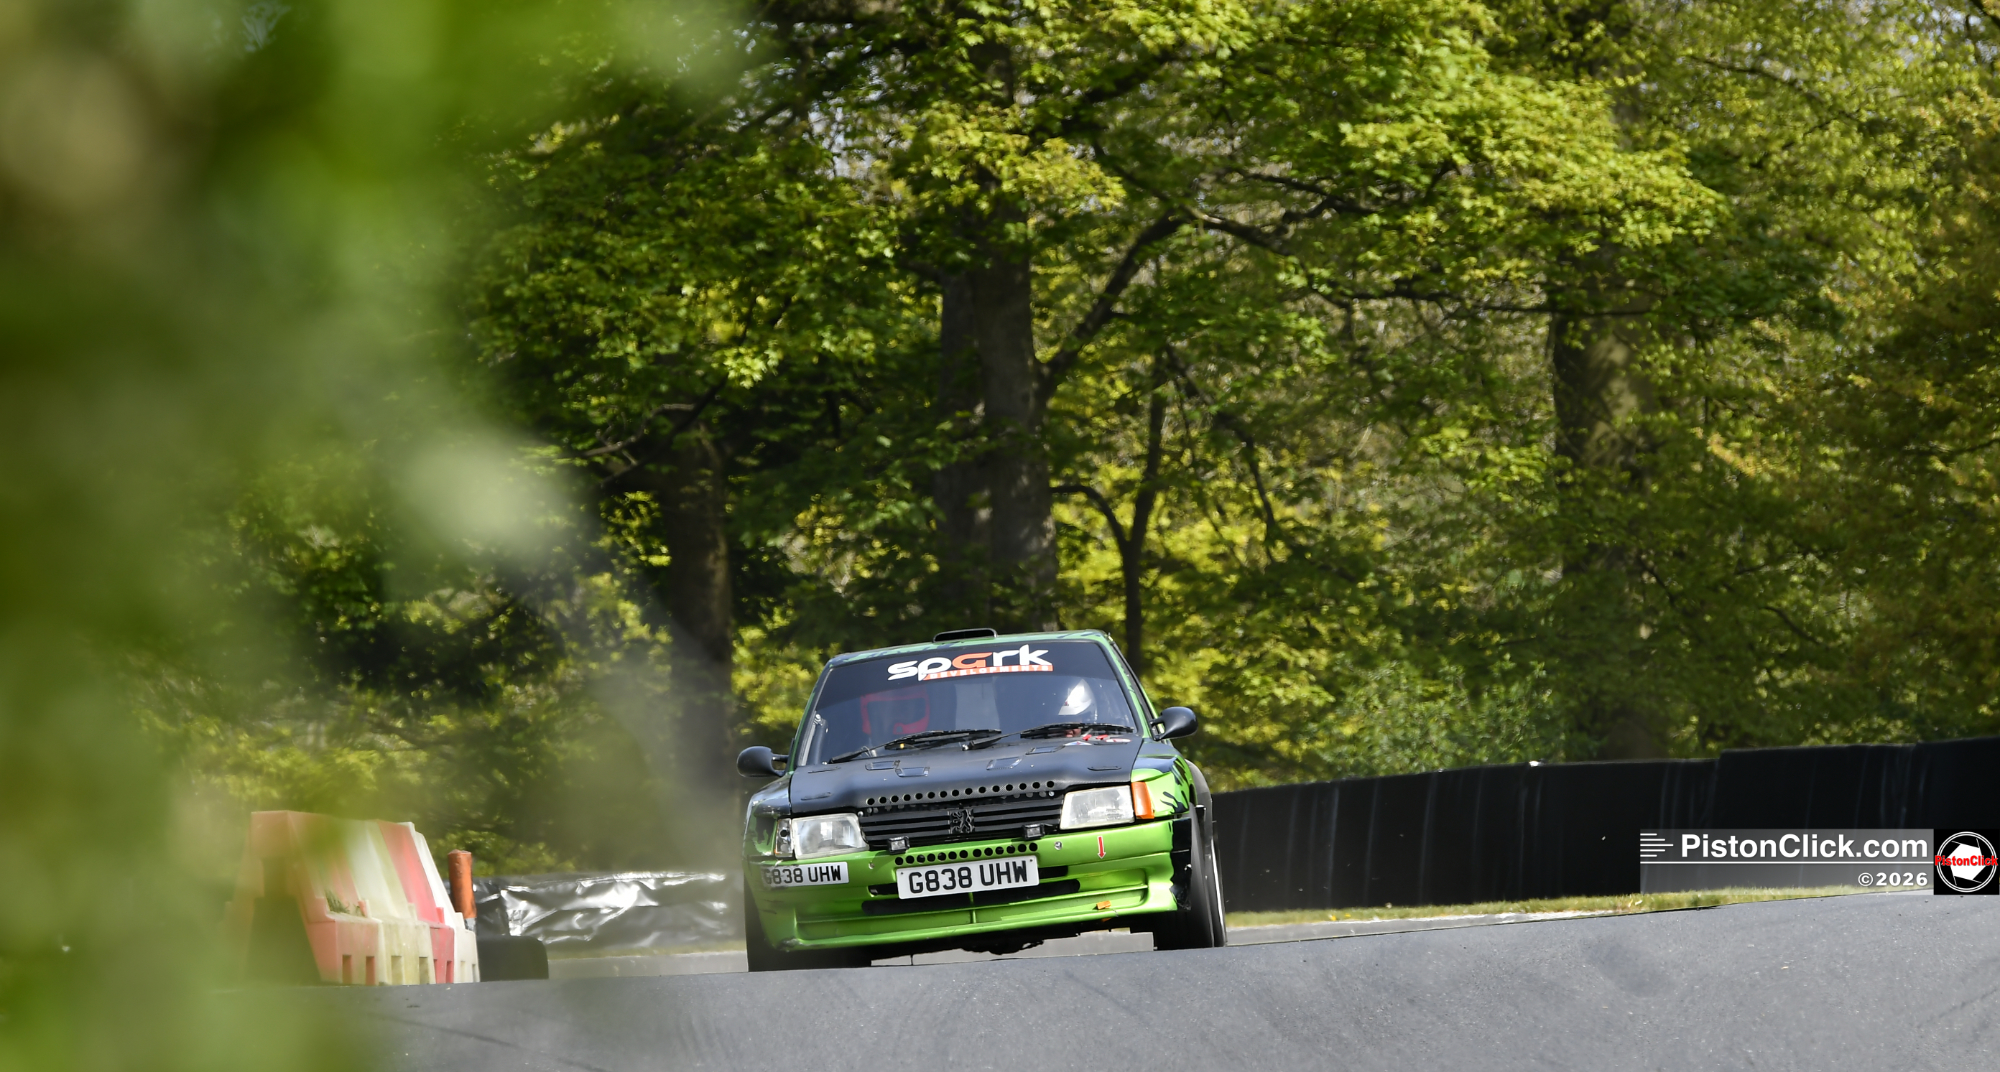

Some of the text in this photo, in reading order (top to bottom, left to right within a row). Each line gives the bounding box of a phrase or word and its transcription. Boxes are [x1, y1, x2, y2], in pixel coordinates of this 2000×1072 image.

[887, 644, 1053, 681] spark
[929, 664, 1049, 679] DEVELOPMENTS
[763, 863, 842, 885] G838 UHW
[908, 860, 1028, 894] G838 UHW
